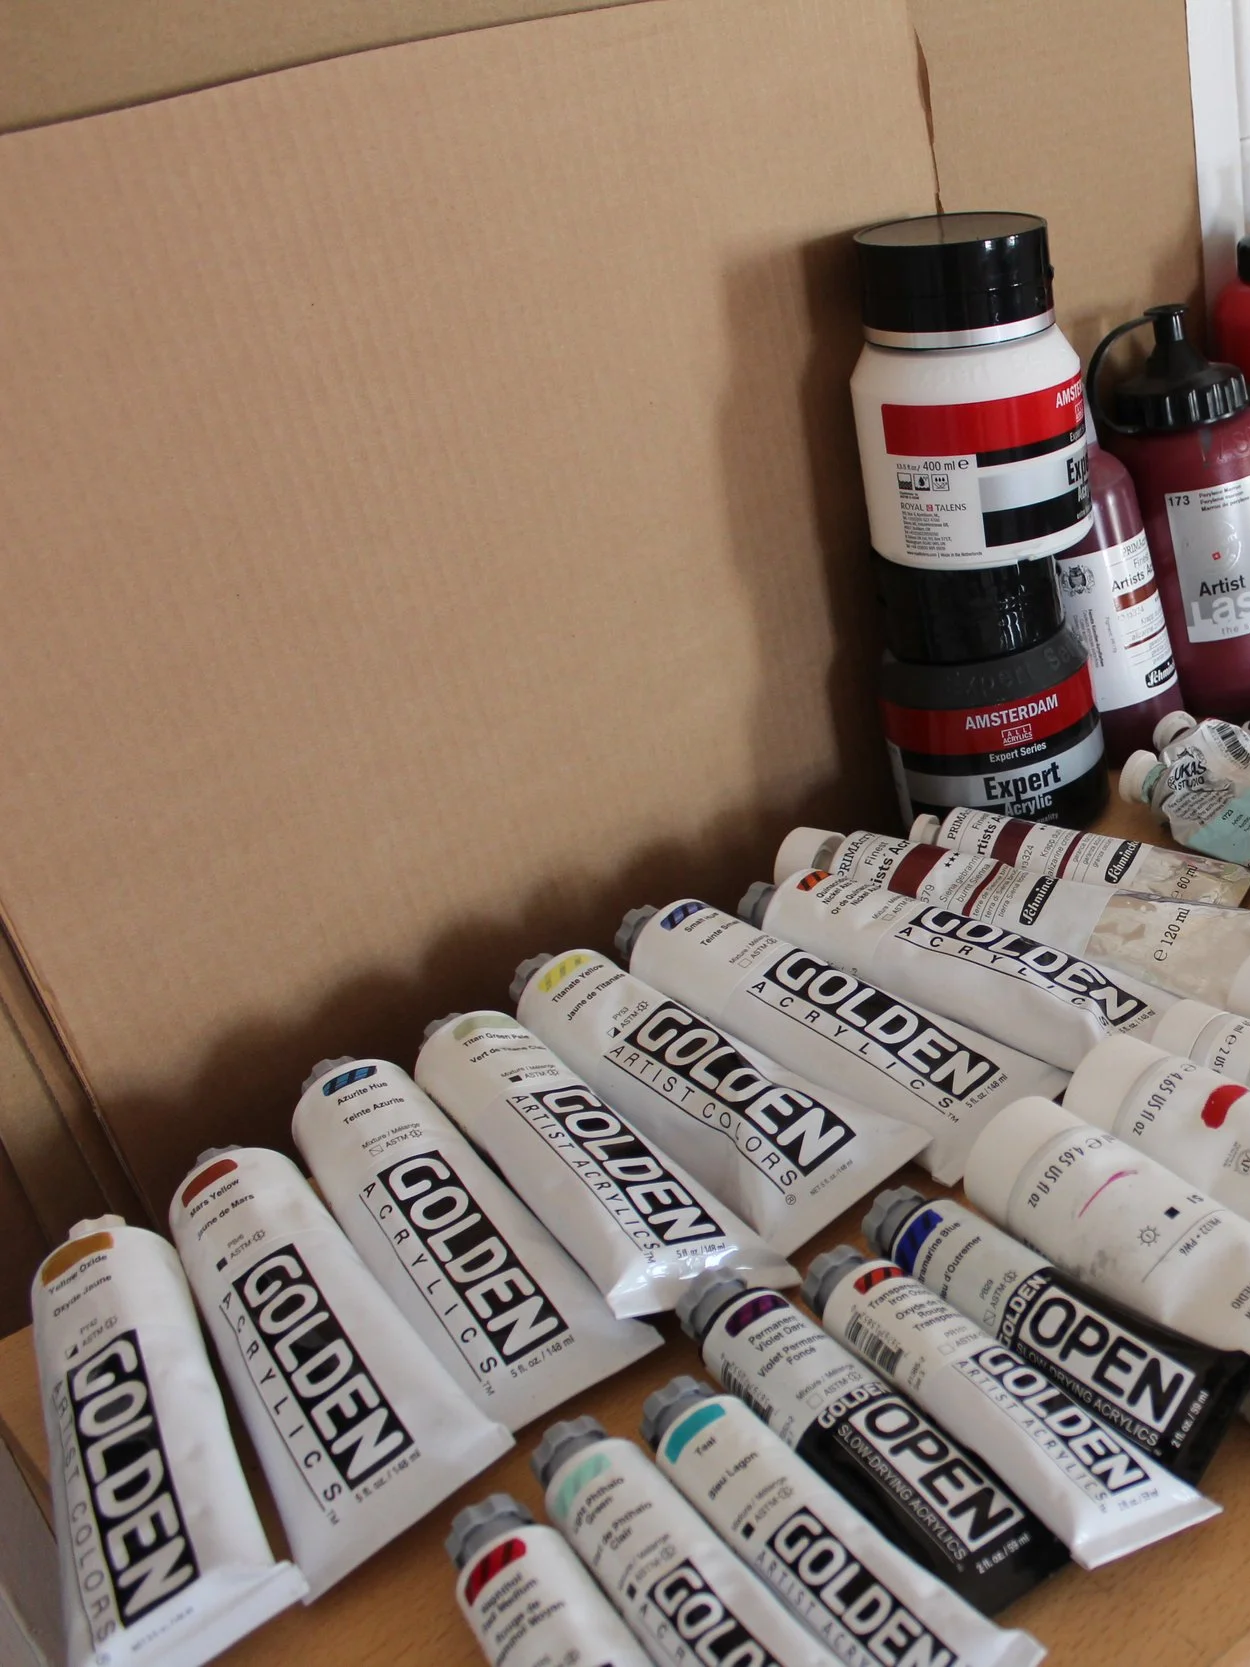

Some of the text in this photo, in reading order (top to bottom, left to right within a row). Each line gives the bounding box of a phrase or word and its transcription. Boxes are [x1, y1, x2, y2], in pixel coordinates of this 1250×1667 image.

[922, 460, 941, 471] 400
[944, 460, 956, 471] ml
[900, 502, 967, 512] ROYAL TALENS
[1169, 495, 1191, 507] 173
[1199, 575, 1247, 597] Artist
[965, 694, 1059, 730] AMSTERDAM
[1003, 732, 1033, 744] ACRYLICS
[1006, 727, 1030, 739] ALL
[989, 741, 1047, 763] Expert Series
[983, 761, 1062, 801] Expert
[1003, 793, 1054, 817] Acrylic
[864, 841, 890, 866] Finest
[1040, 841, 1056, 858] Krapp
[1111, 839, 1142, 884] Schmincke
[955, 863, 991, 903] burnt Sienna
[1177, 864, 1199, 890] 60 ml
[822, 888, 841, 905] Nickel
[851, 891, 870, 907] Nickel
[939, 882, 958, 903] Siena
[1007, 886, 1019, 903] Siena
[699, 927, 722, 947] Teinte
[1161, 907, 1191, 946] 120 ml
[750, 942, 769, 959] ASTM
[918, 905, 1139, 1023] GOLDEN
[551, 963, 606, 1004] Titanate Yellow
[567, 971, 627, 1021] Jaune Titanate
[619, 1008, 641, 1029] ASTM
[773, 953, 989, 1097] GOLDEN
[463, 1034, 485, 1048] Titan
[751, 980, 953, 1108] ACRYLICS
[469, 1050, 489, 1064] Vert
[337, 1084, 369, 1106] Azurite
[632, 1005, 846, 1169] GOLDEN
[343, 1096, 405, 1126] Teinte Azurite
[609, 1043, 799, 1188] ARTIST COLORS
[1132, 1069, 1184, 1137] 4.65 US oz
[385, 1133, 410, 1148] ASTM
[511, 1095, 661, 1253] ARTIST ACRYLICS
[542, 1088, 720, 1243] GOLDEN
[1027, 1146, 1086, 1210] 4.65 US oz
[207, 1177, 241, 1203] Yellow
[229, 1192, 256, 1211] Mars
[940, 1220, 962, 1239] Blue
[229, 1239, 252, 1260] ASTM
[386, 1158, 561, 1357] GOLDEN
[943, 1235, 983, 1284] d'Outremer
[48, 1252, 109, 1296] Yellow Oxide
[362, 1180, 498, 1376] ACRYLICS
[52, 1273, 113, 1317] Oxyde Jaune
[895, 1300, 926, 1320] Oxyde
[998, 1273, 1049, 1348] GOLDEN
[748, 1315, 799, 1345] Permanent
[753, 1321, 808, 1353] Violet Dark
[546, 1334, 575, 1357] 148 ml
[787, 1345, 818, 1367] Foncé
[1028, 1296, 1187, 1425] OPEN
[240, 1252, 414, 1484] GOLDEN
[757, 1352, 788, 1379] Violet
[220, 1291, 344, 1502] ACRYLICS
[823, 1377, 850, 1398] ASTM
[816, 1383, 892, 1429] GOLDEN
[976, 1344, 1147, 1492] GOLDEN
[956, 1360, 1019, 1412] ARTIST
[1022, 1418, 1109, 1502] ACRYLICS
[1092, 1398, 1160, 1448] ACRYLICS
[695, 1435, 719, 1457] Teal
[723, 1451, 758, 1480] Lagon
[864, 1402, 1014, 1542] OPEN
[68, 1335, 200, 1628] GOLDEN
[585, 1476, 625, 1507] Phthalo
[837, 1422, 913, 1500] SLOW-DRYING
[907, 1496, 967, 1562] ACRYLICS
[54, 1381, 117, 1642] ARTIST COLORS
[584, 1496, 614, 1526] Green
[611, 1501, 653, 1530] Phthalo
[755, 1551, 817, 1616] ARTIST
[773, 1512, 953, 1667] GOLDEN
